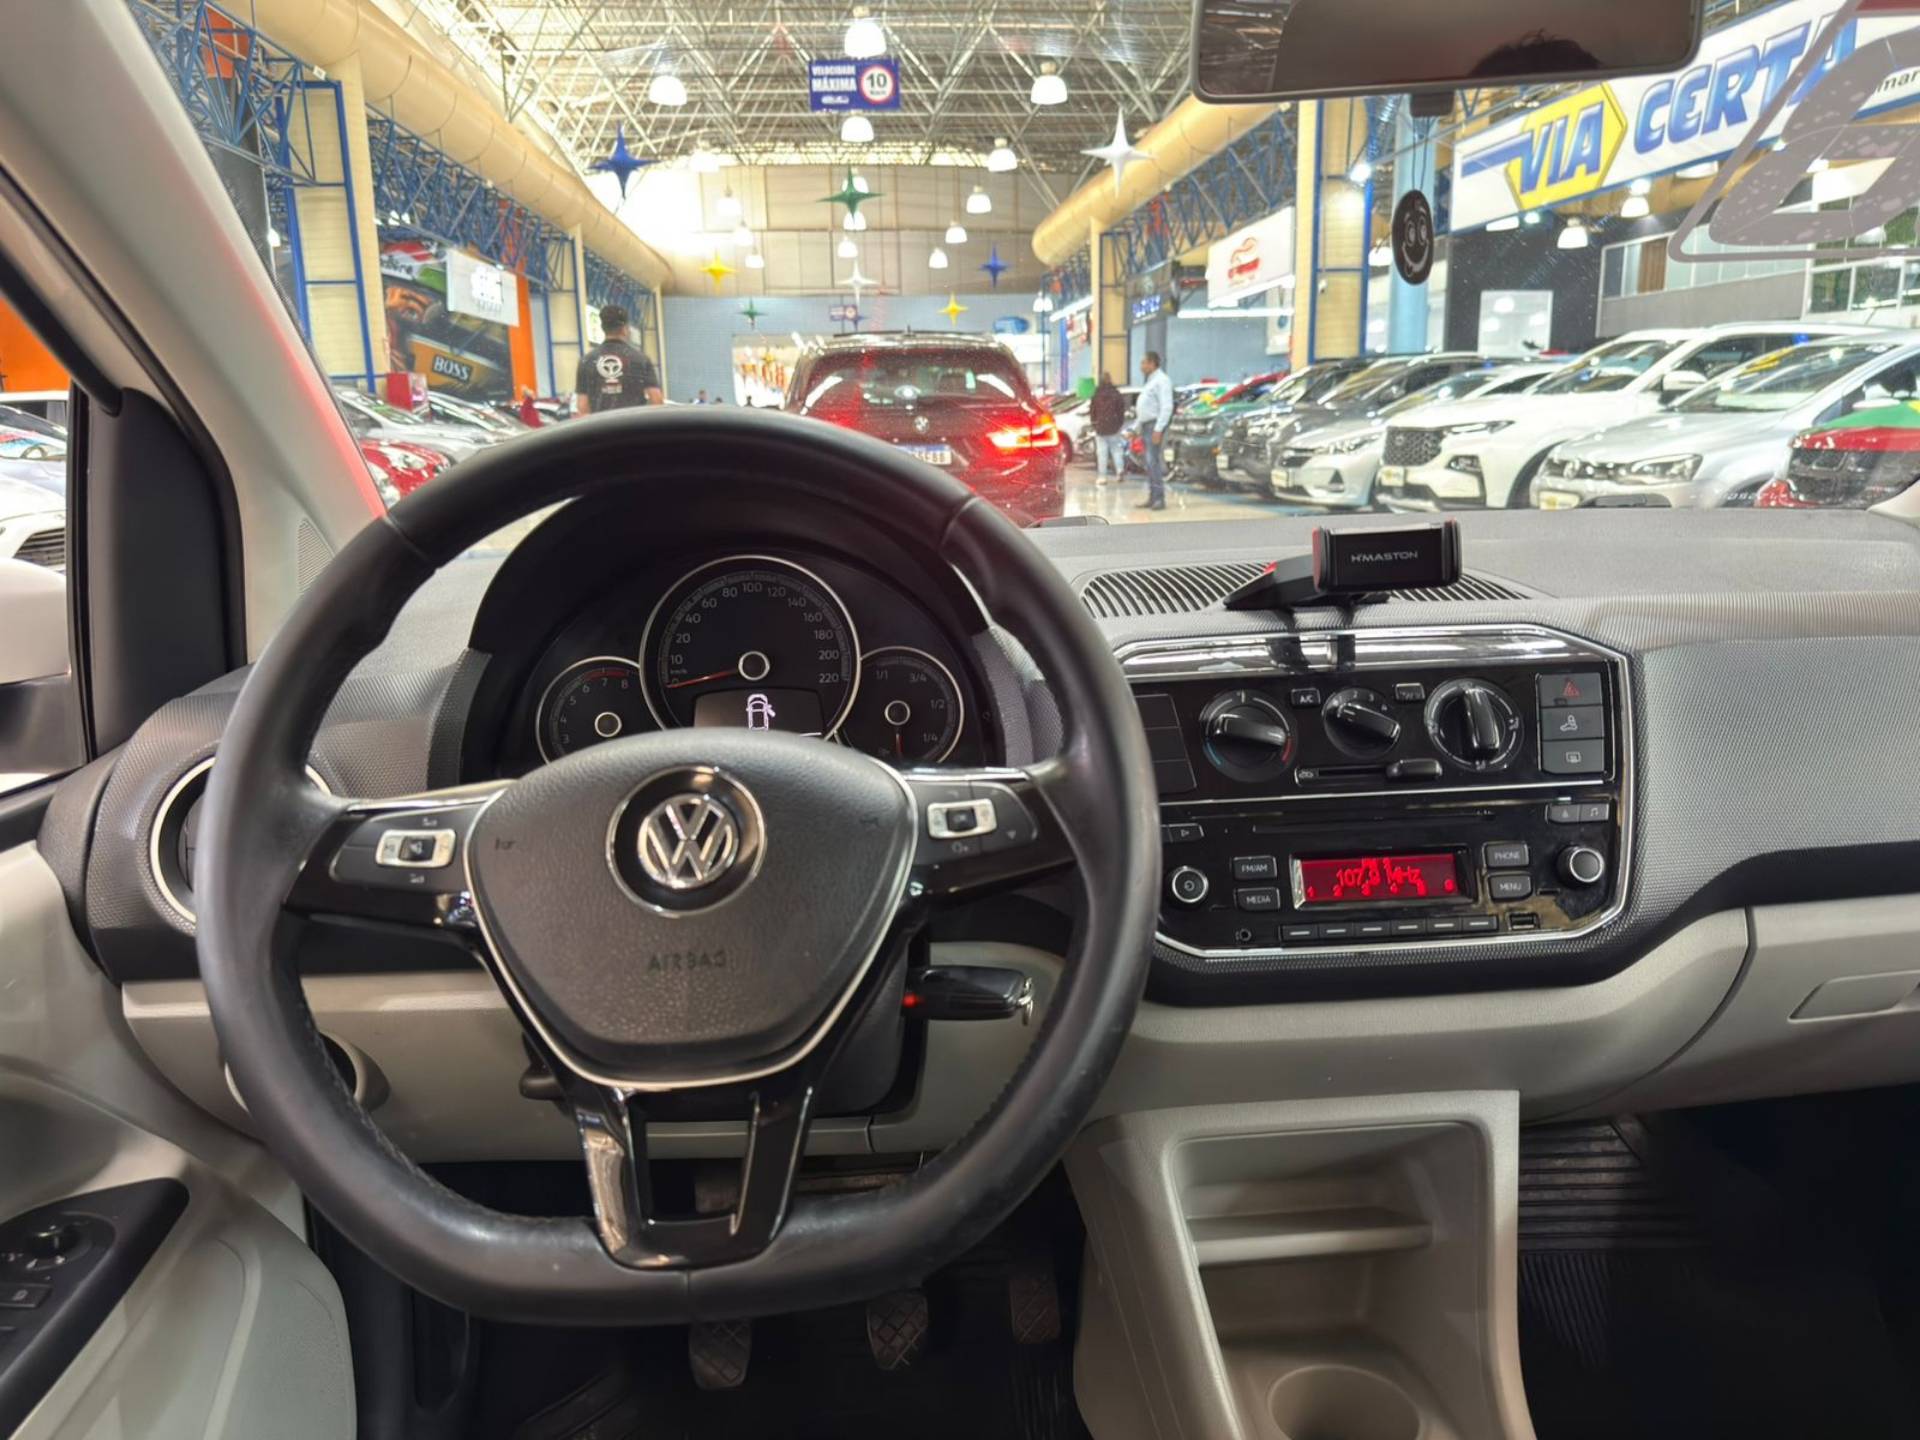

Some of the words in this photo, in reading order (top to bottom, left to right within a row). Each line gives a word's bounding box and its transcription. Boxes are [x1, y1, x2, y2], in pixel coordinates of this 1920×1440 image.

[811, 77, 857, 92] MÁXIMA
[866, 73, 887, 88] 10
[1480, 100, 1604, 194] VIA
[1633, 10, 1858, 155] CERTA
[433, 355, 469, 381] BOSS
[721, 587, 738, 598] 80
[743, 582, 763, 593] 100
[767, 587, 786, 598] 120
[701, 598, 718, 608] 60
[787, 597, 807, 608] 140
[685, 613, 701, 623] 40
[803, 612, 823, 622] 160
[675, 633, 691, 643] 20
[814, 630, 834, 640] 180
[671, 654, 683, 665] 10
[818, 649, 839, 660] 200
[601, 678, 608, 687] 7
[818, 672, 839, 683] 220
[582, 684, 590, 693] 6
[621, 680, 629, 689] 8
[569, 697, 577, 705] 5
[1494, 850, 1521, 860] PHONE
[1499, 882, 1522, 891] MENU
